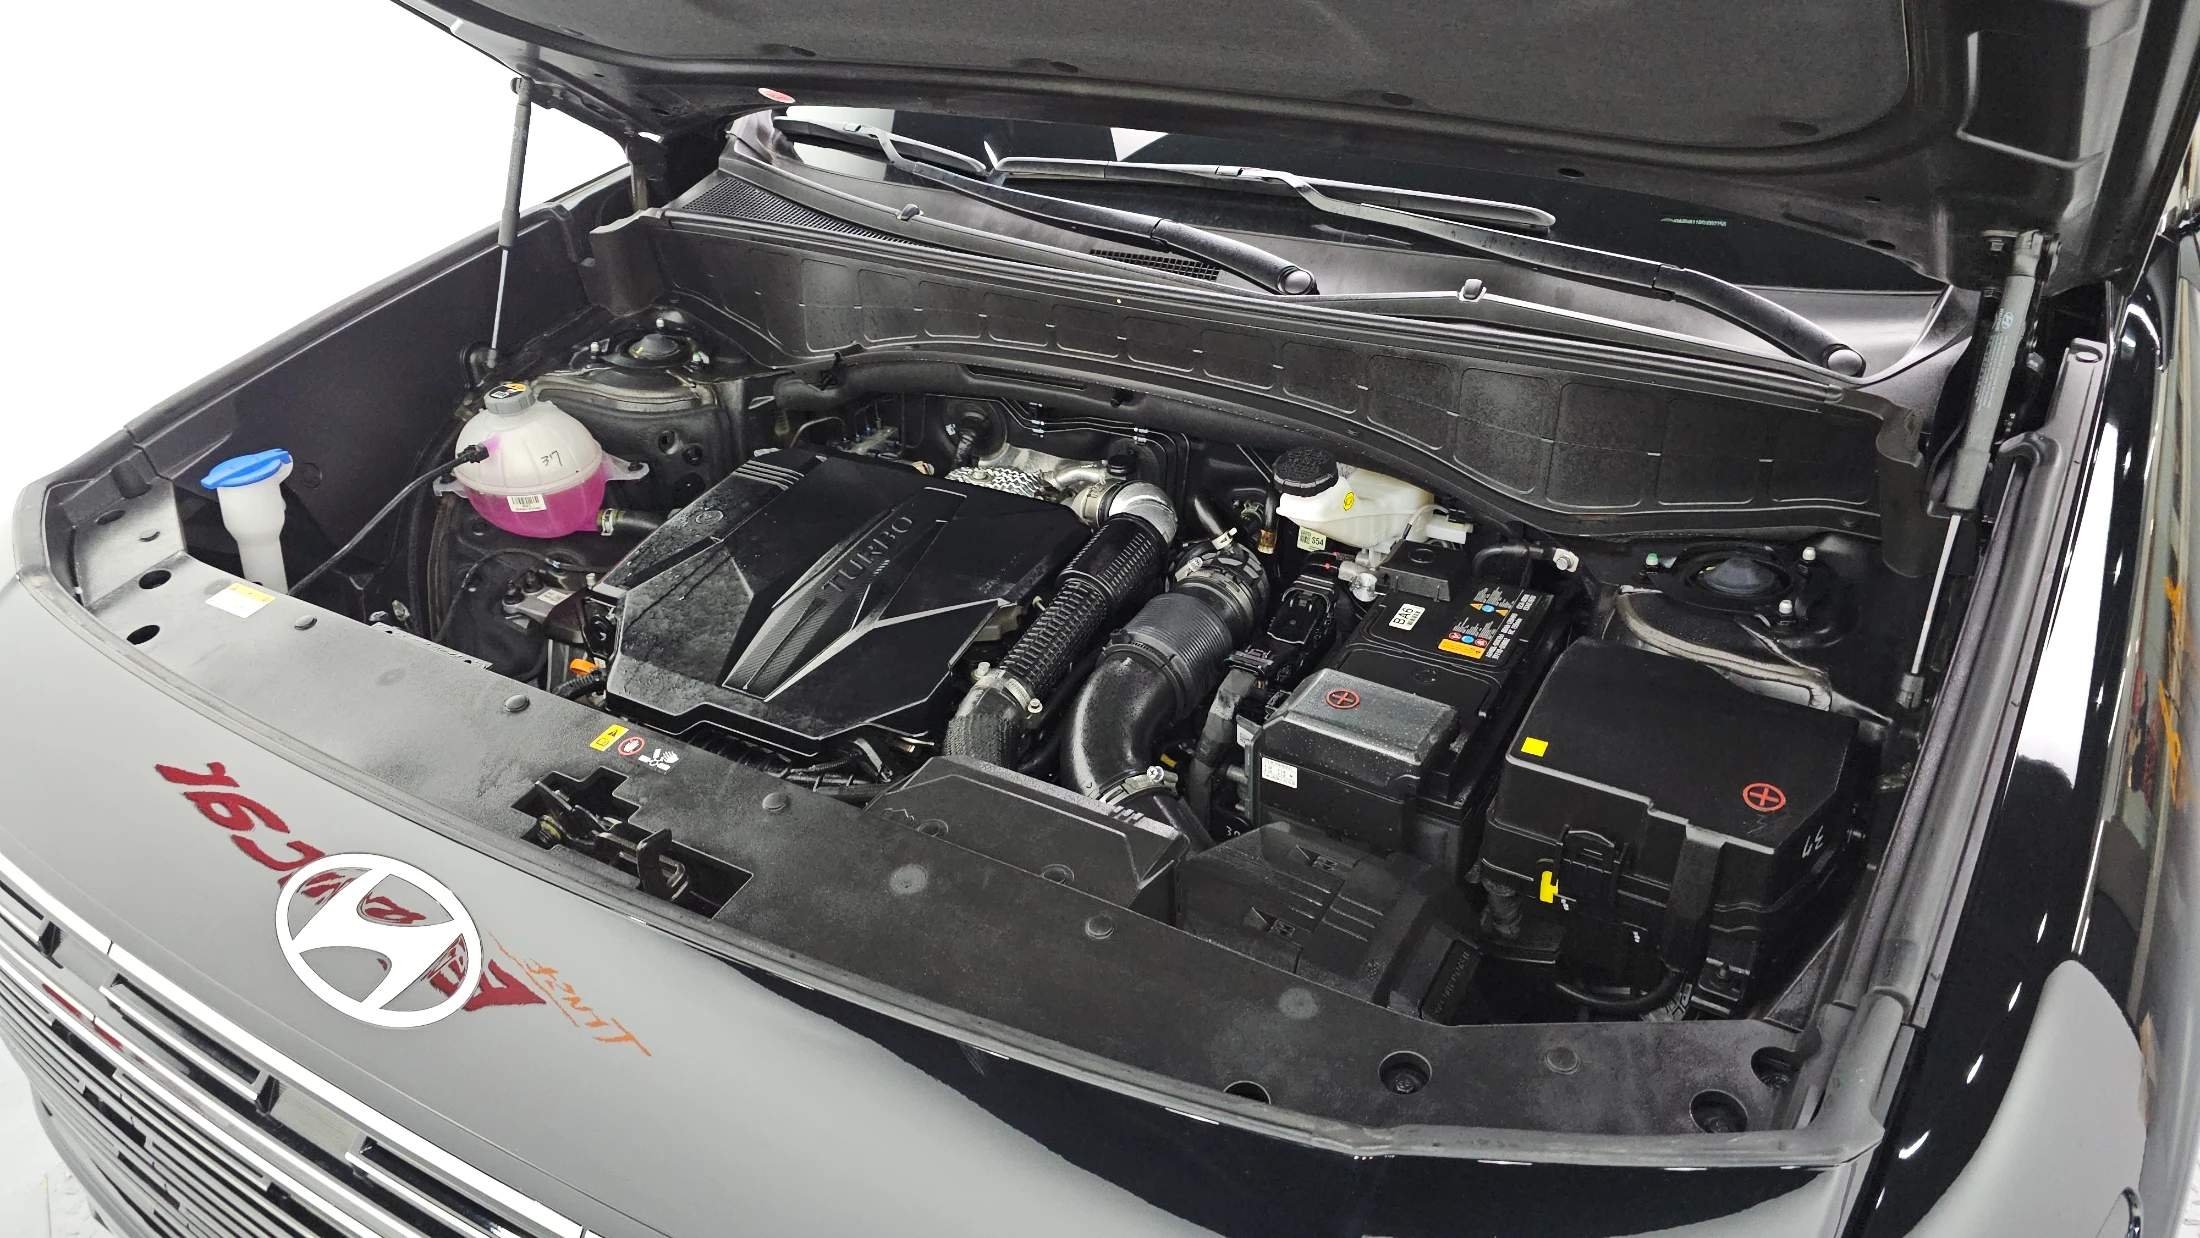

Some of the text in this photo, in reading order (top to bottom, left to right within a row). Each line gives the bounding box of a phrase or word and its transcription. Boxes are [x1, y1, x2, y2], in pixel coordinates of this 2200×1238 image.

[540, 450, 563, 467] 37
[821, 516, 913, 592] TURBO
[1393, 607, 1414, 625] BA6
